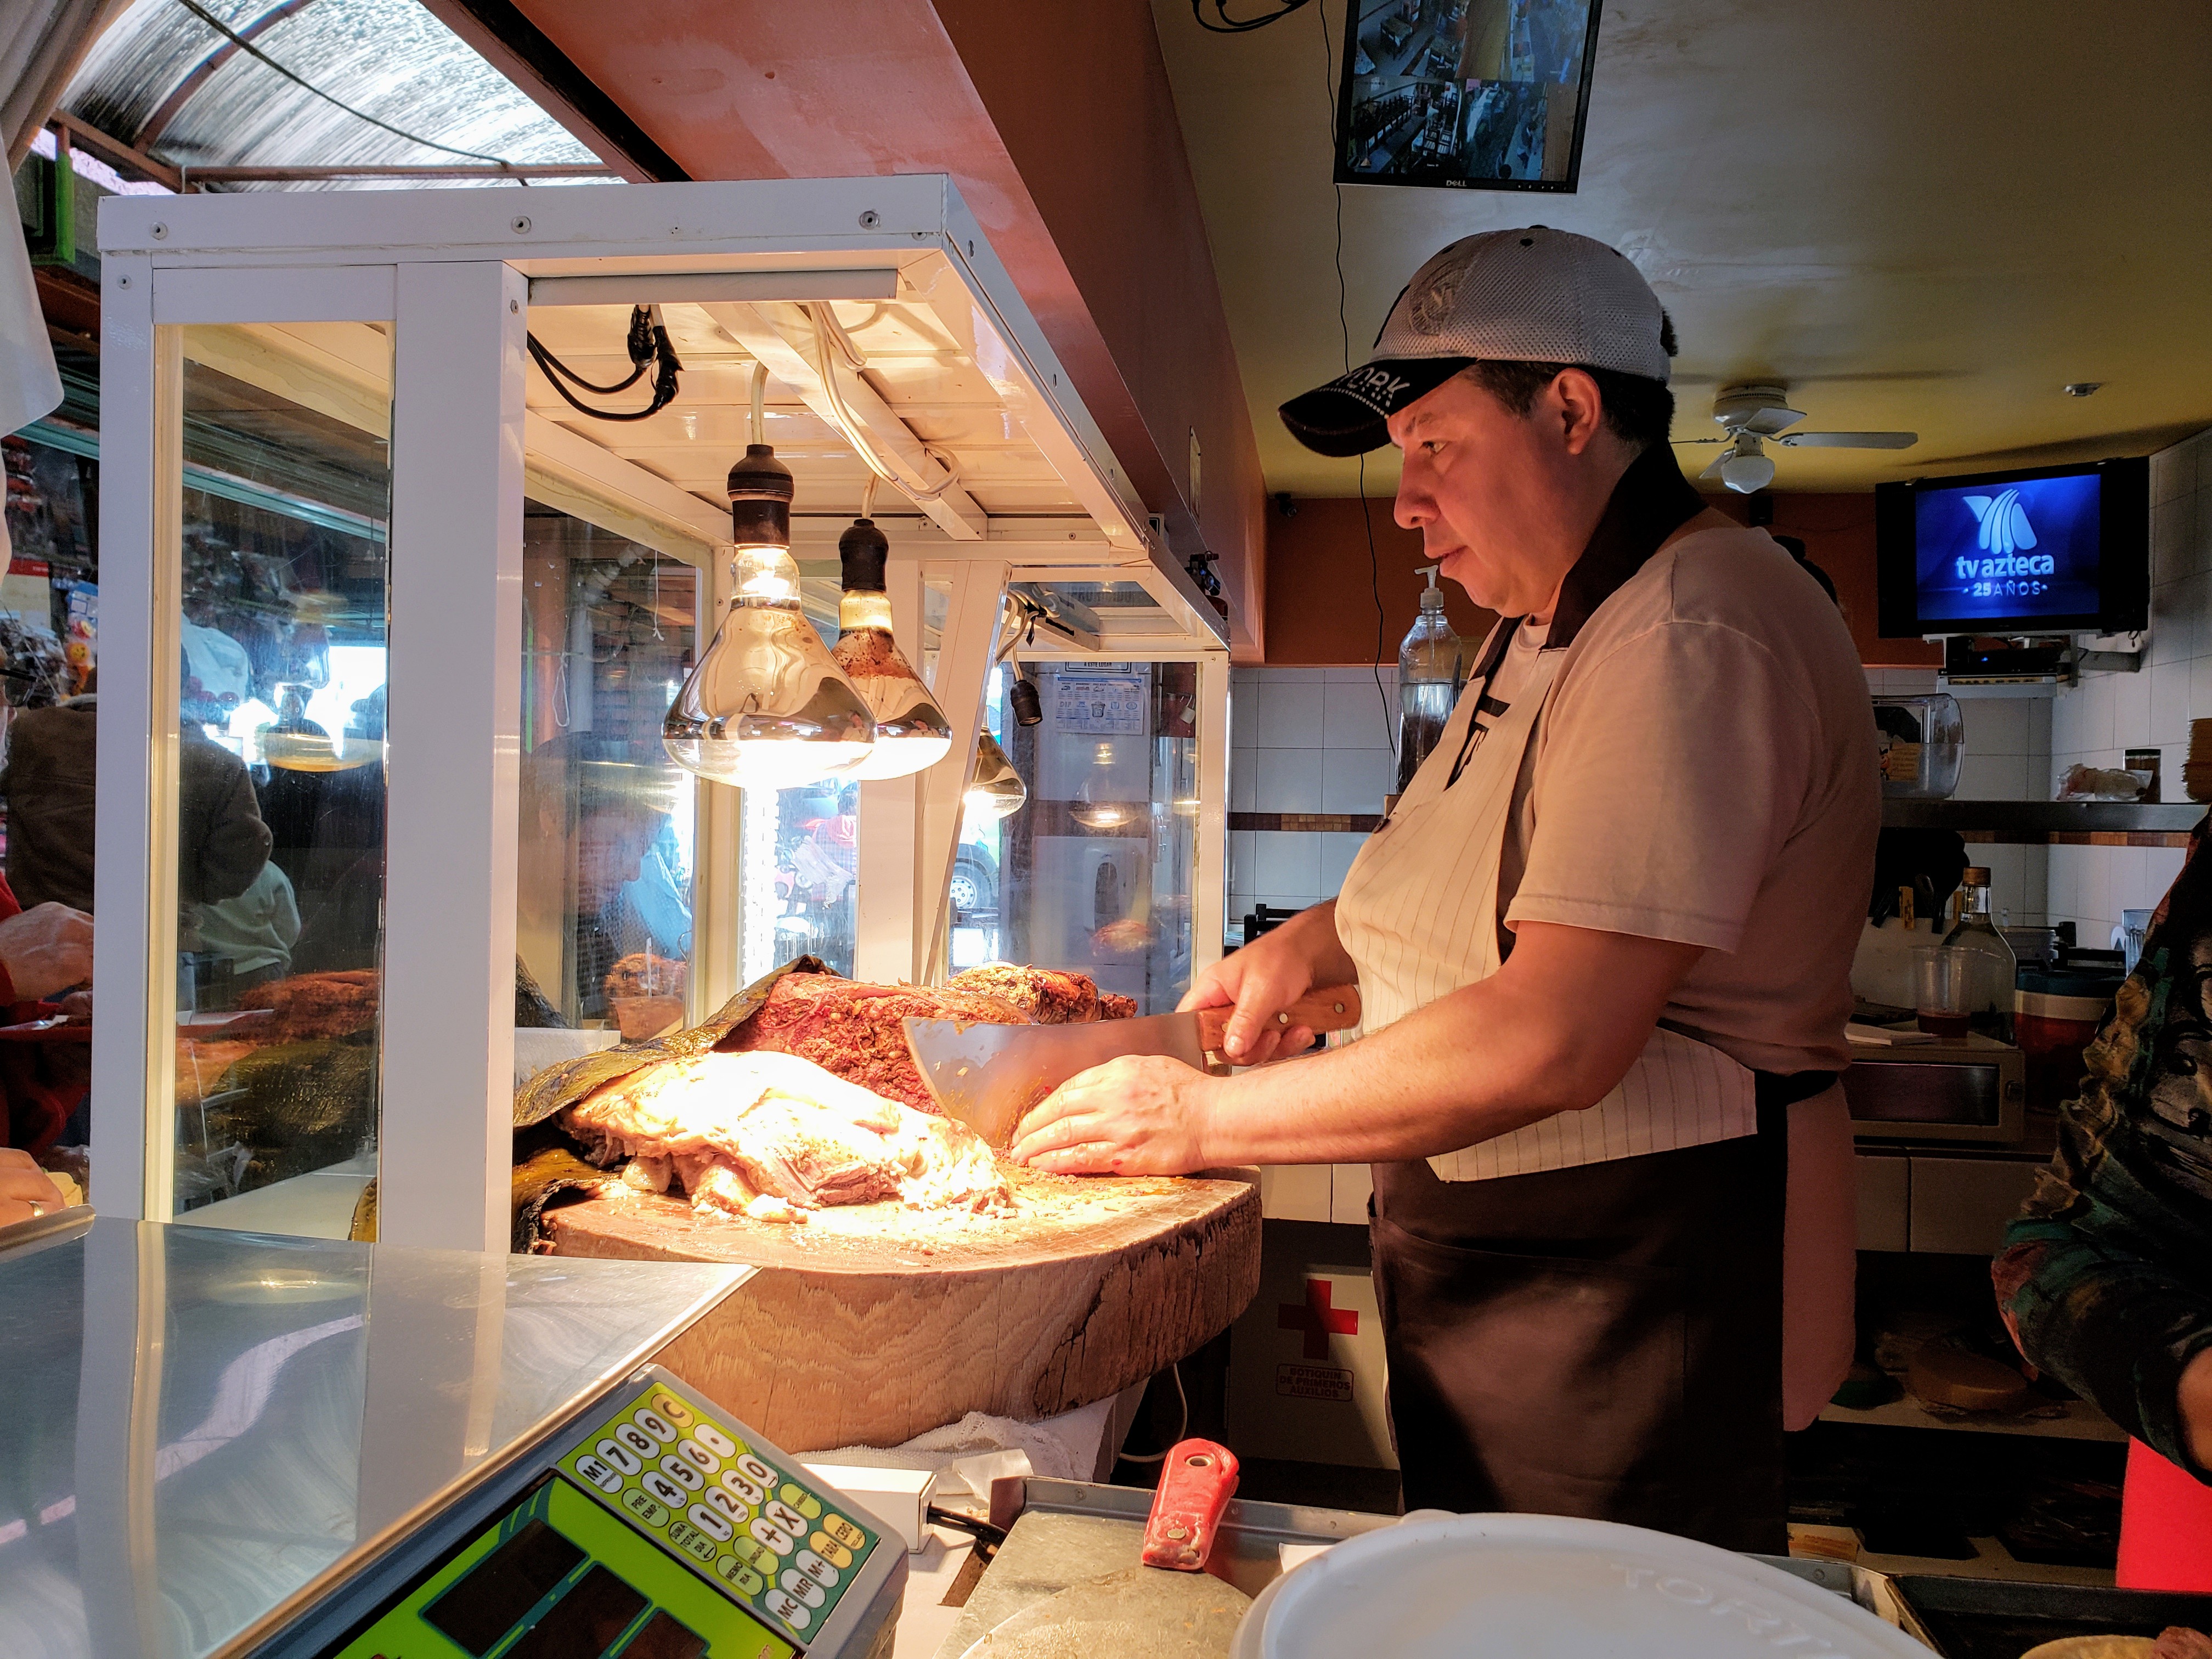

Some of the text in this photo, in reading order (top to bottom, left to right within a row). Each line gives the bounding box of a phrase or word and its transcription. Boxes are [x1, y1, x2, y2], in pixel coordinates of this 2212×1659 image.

[1973, 580, 2040, 596] 25 AÑOS
[1279, 1375, 1350, 1390] DE PRIMEROS
[1290, 1368, 1341, 1380] BOTIQUIN
[1291, 1385, 1339, 1398] AUXILIOS
[663, 1401, 686, 1418] C
[645, 1417, 666, 1434] 9
[627, 1432, 650, 1449] 8
[606, 1446, 629, 1467] 7
[689, 1447, 710, 1464] 6
[583, 1460, 607, 1481] M1
[670, 1462, 693, 1482] 5
[747, 1461, 767, 1478] 0
[654, 1479, 677, 1497] 4
[731, 1476, 753, 1496] 3
[631, 1495, 648, 1510] PRE
[715, 1493, 740, 1513] 2
[700, 1511, 722, 1529] 1
[670, 1523, 688, 1539] SUMA
[680, 1531, 700, 1547] TOTAL
[835, 1522, 853, 1541] CERO
[821, 1540, 841, 1559] TARA
[725, 1562, 743, 1581] MEMO
[793, 1578, 813, 1599] MR
[777, 1598, 798, 1620] MC
